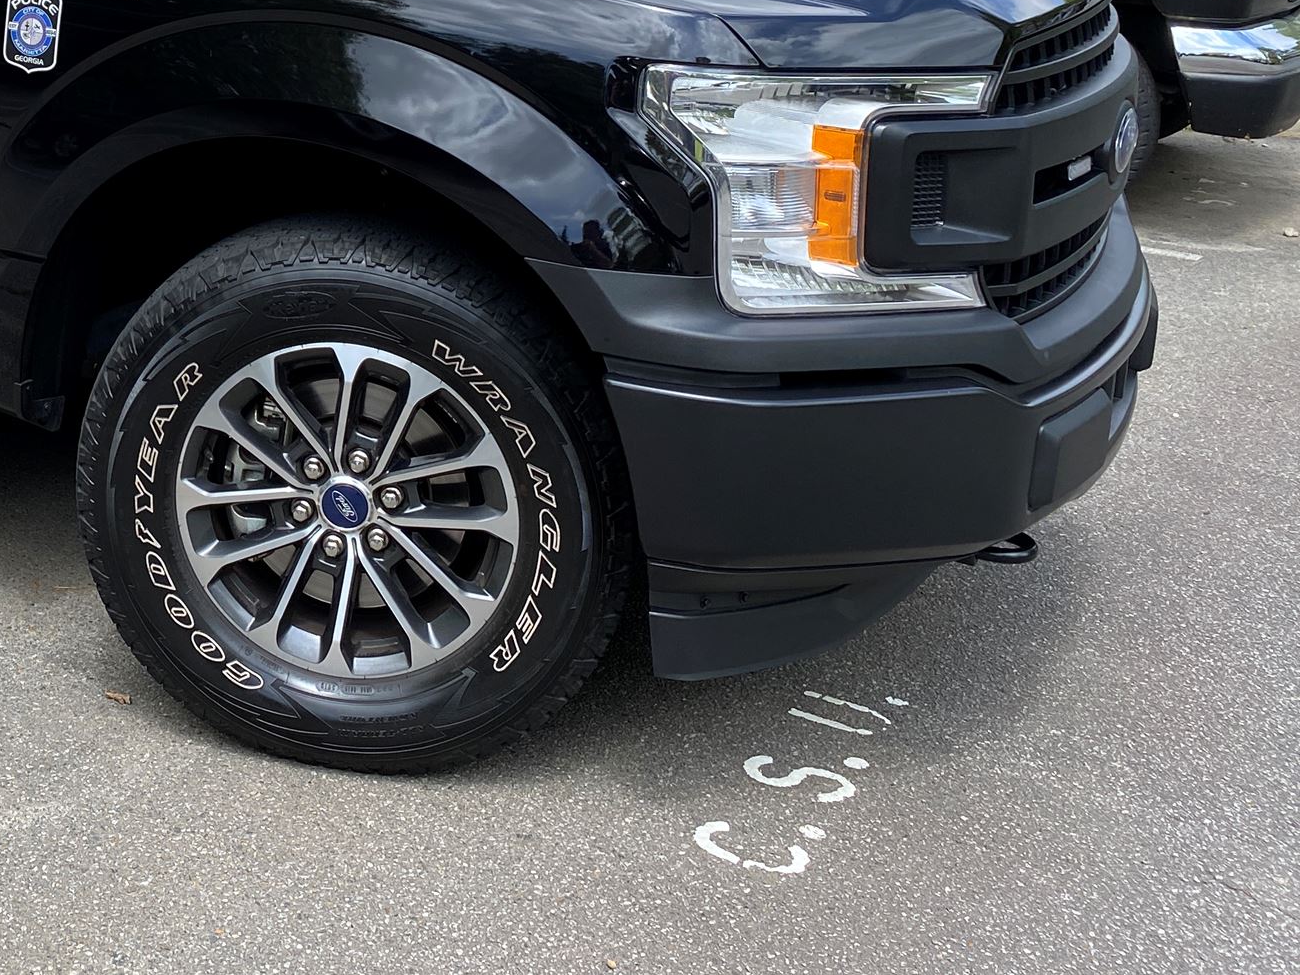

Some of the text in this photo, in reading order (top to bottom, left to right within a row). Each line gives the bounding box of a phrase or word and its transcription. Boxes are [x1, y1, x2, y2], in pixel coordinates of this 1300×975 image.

[14, 54, 44, 65] GEORGIA
[132, 362, 264, 691] GOODYEAR
[334, 492, 356, 519] Ford
[432, 339, 561, 673] WRANGLER
